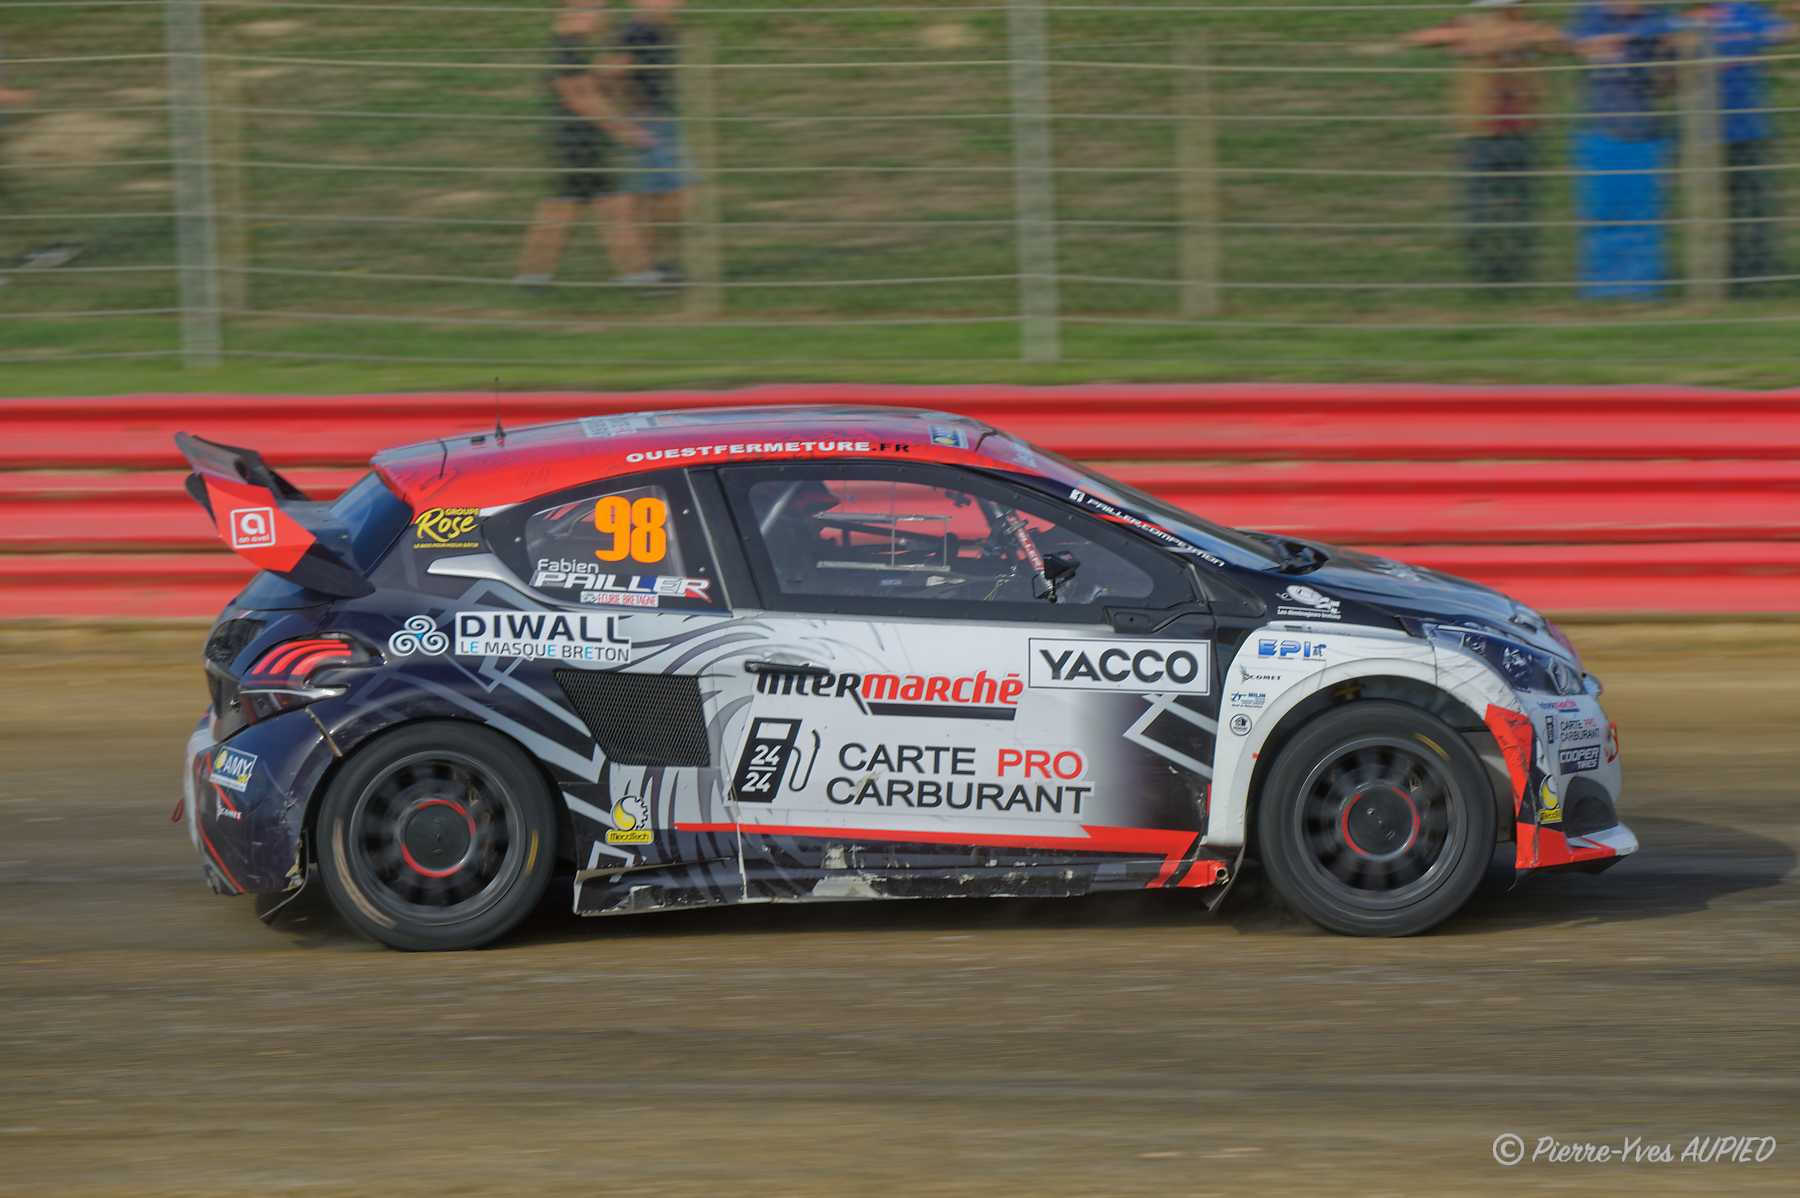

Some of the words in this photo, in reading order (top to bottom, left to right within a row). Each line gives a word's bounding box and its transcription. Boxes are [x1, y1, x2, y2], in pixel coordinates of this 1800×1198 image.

[626, 440, 909, 463] OUESTFERMETURE.FR
[415, 507, 479, 543] Rose
[594, 496, 668, 563] 98
[537, 558, 600, 574] Fabien
[530, 572, 711, 603] PAILLER
[460, 614, 629, 645] DIWALL
[460, 640, 479, 654] LE
[484, 641, 556, 661] MASQUE
[562, 644, 629, 662] BRETON
[1039, 648, 1198, 685] YACCO
[753, 744, 782, 766] 24
[839, 743, 977, 776] CARTE
[996, 748, 1084, 780] PRO
[1560, 749, 1600, 763] COOPER
[741, 773, 772, 793] 24
[826, 777, 1092, 815] CARBURANT
